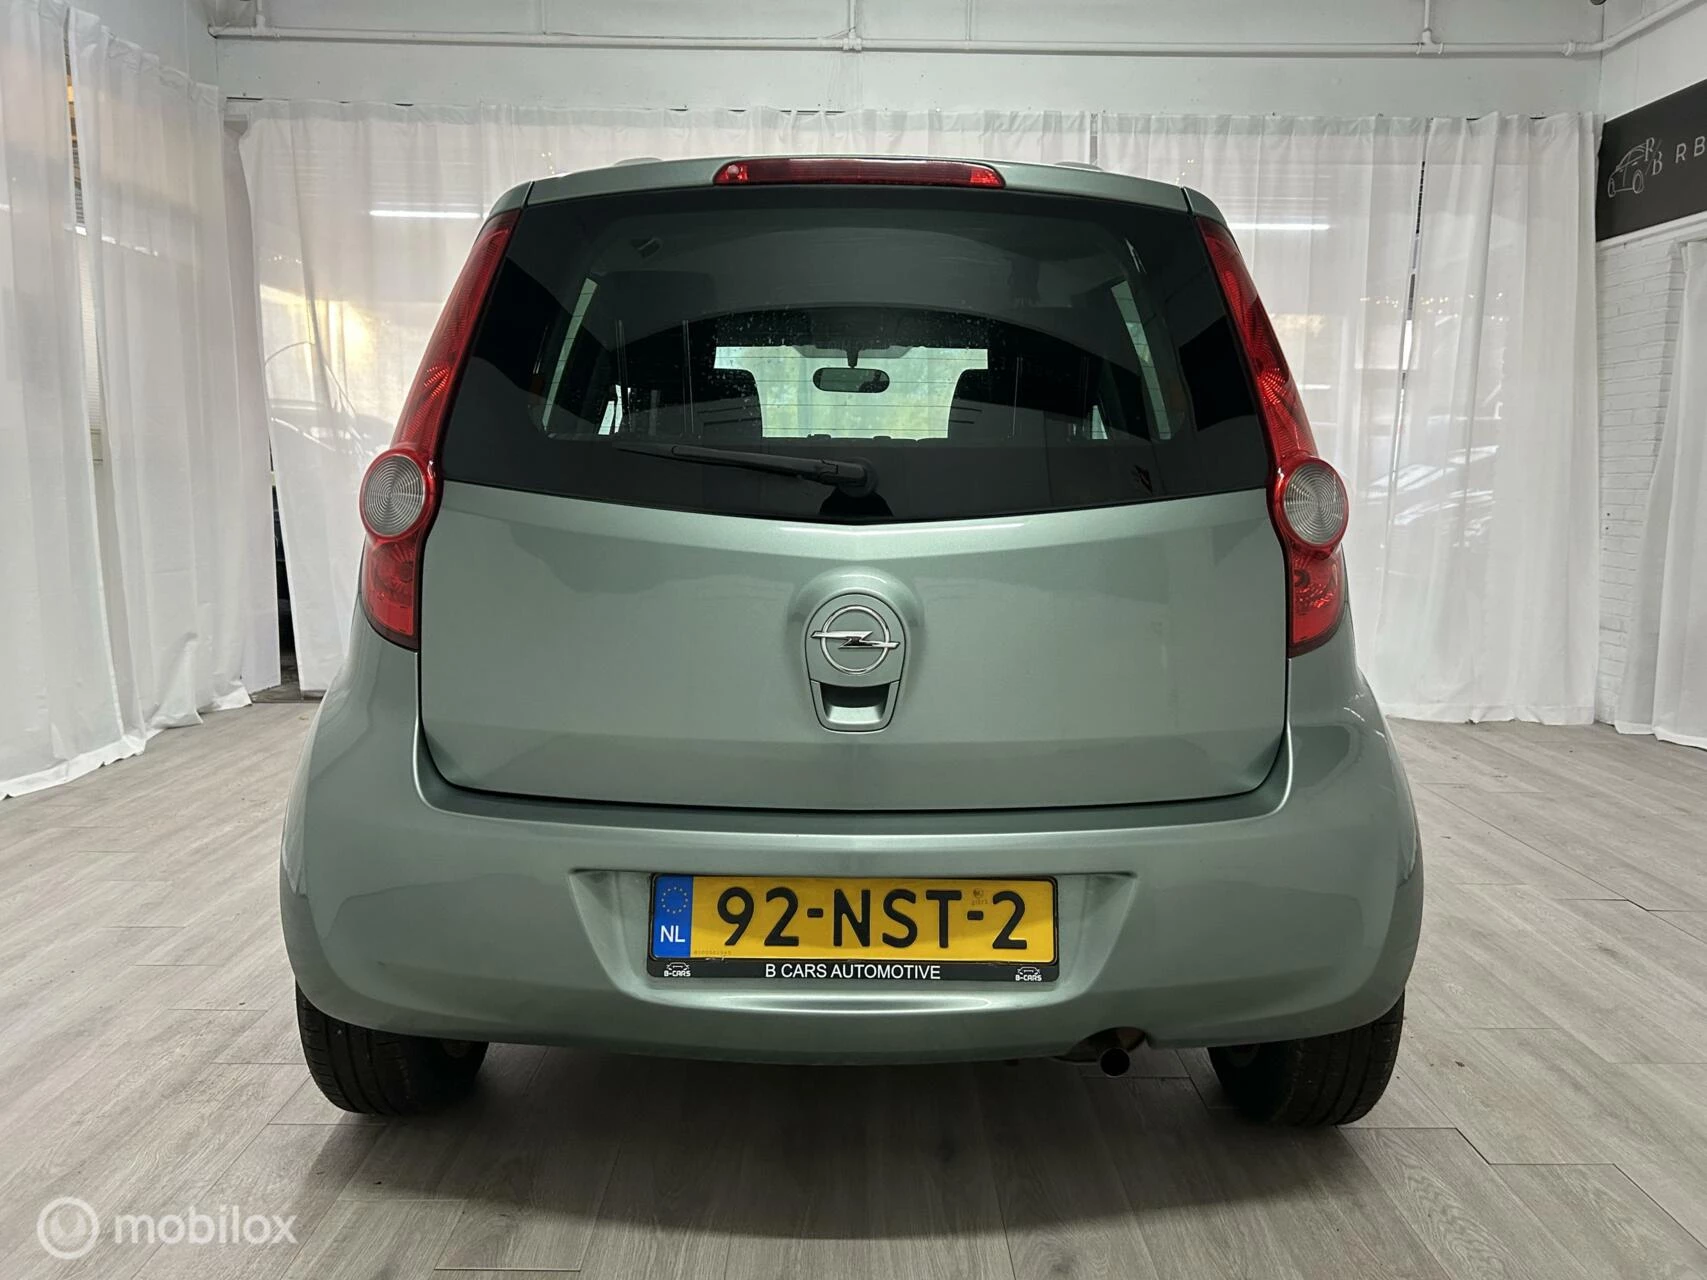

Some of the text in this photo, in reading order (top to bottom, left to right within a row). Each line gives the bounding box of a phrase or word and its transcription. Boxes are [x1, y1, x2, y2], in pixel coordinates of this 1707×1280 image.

[716, 886, 1028, 950] 92-NST-2
[660, 925, 686, 943] NL
[765, 963, 941, 979] B CARS AUTOMOTIVE
